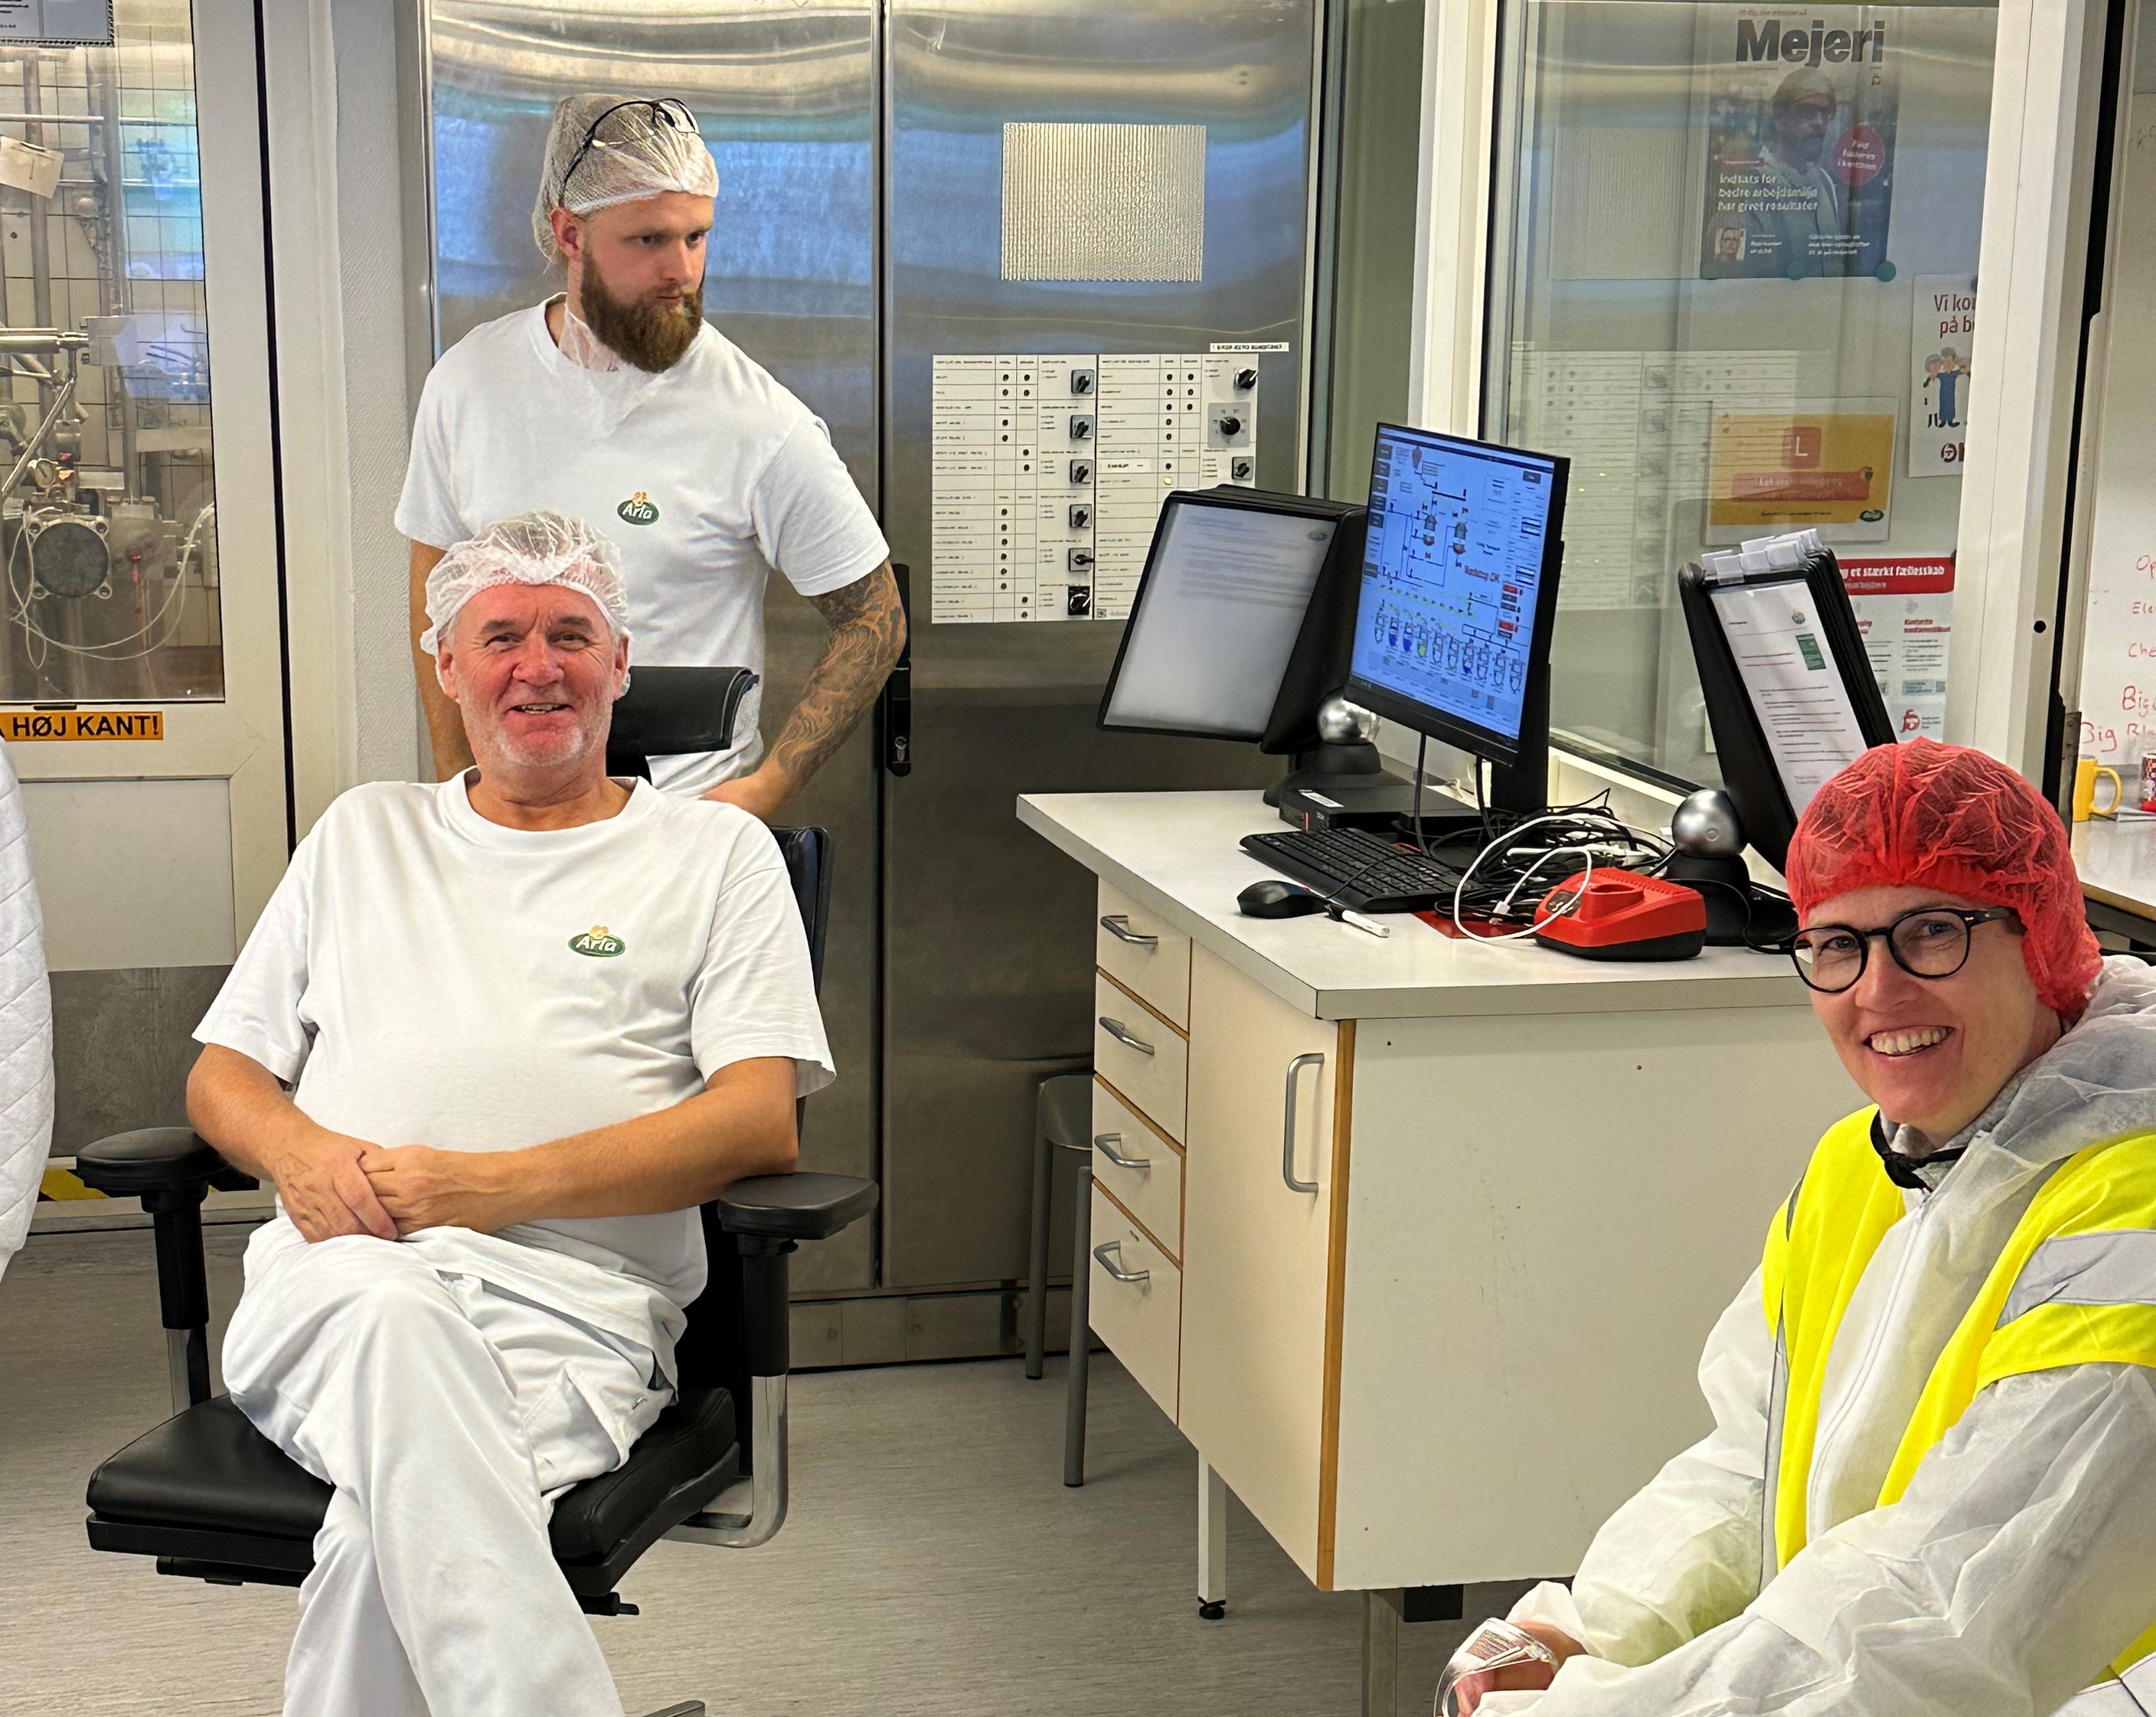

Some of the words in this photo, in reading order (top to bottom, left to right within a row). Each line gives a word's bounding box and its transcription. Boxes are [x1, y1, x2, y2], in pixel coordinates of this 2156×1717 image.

[1735, 20, 1886, 68] Mejeri
[1720, 173, 1760, 184] Indsats
[1762, 174, 1776, 184] for
[1718, 188, 1751, 198] bedre
[1717, 201, 1736, 211] har
[1737, 201, 1764, 213] givet
[1766, 201, 1819, 211] resultater
[1934, 293, 1949, 312] Vi
[1939, 315, 1958, 339] på
[1795, 436, 1808, 457] L
[622, 501, 653, 519] Arla
[1862, 566, 1893, 577] stærkt
[1895, 565, 1945, 576] fællesskab
[2122, 685, 2156, 718] Big
[12, 716, 67, 737] HØJ
[77, 715, 159, 736] KANT!
[2080, 721, 2118, 753] Big
[575, 935, 618, 952] Arla
